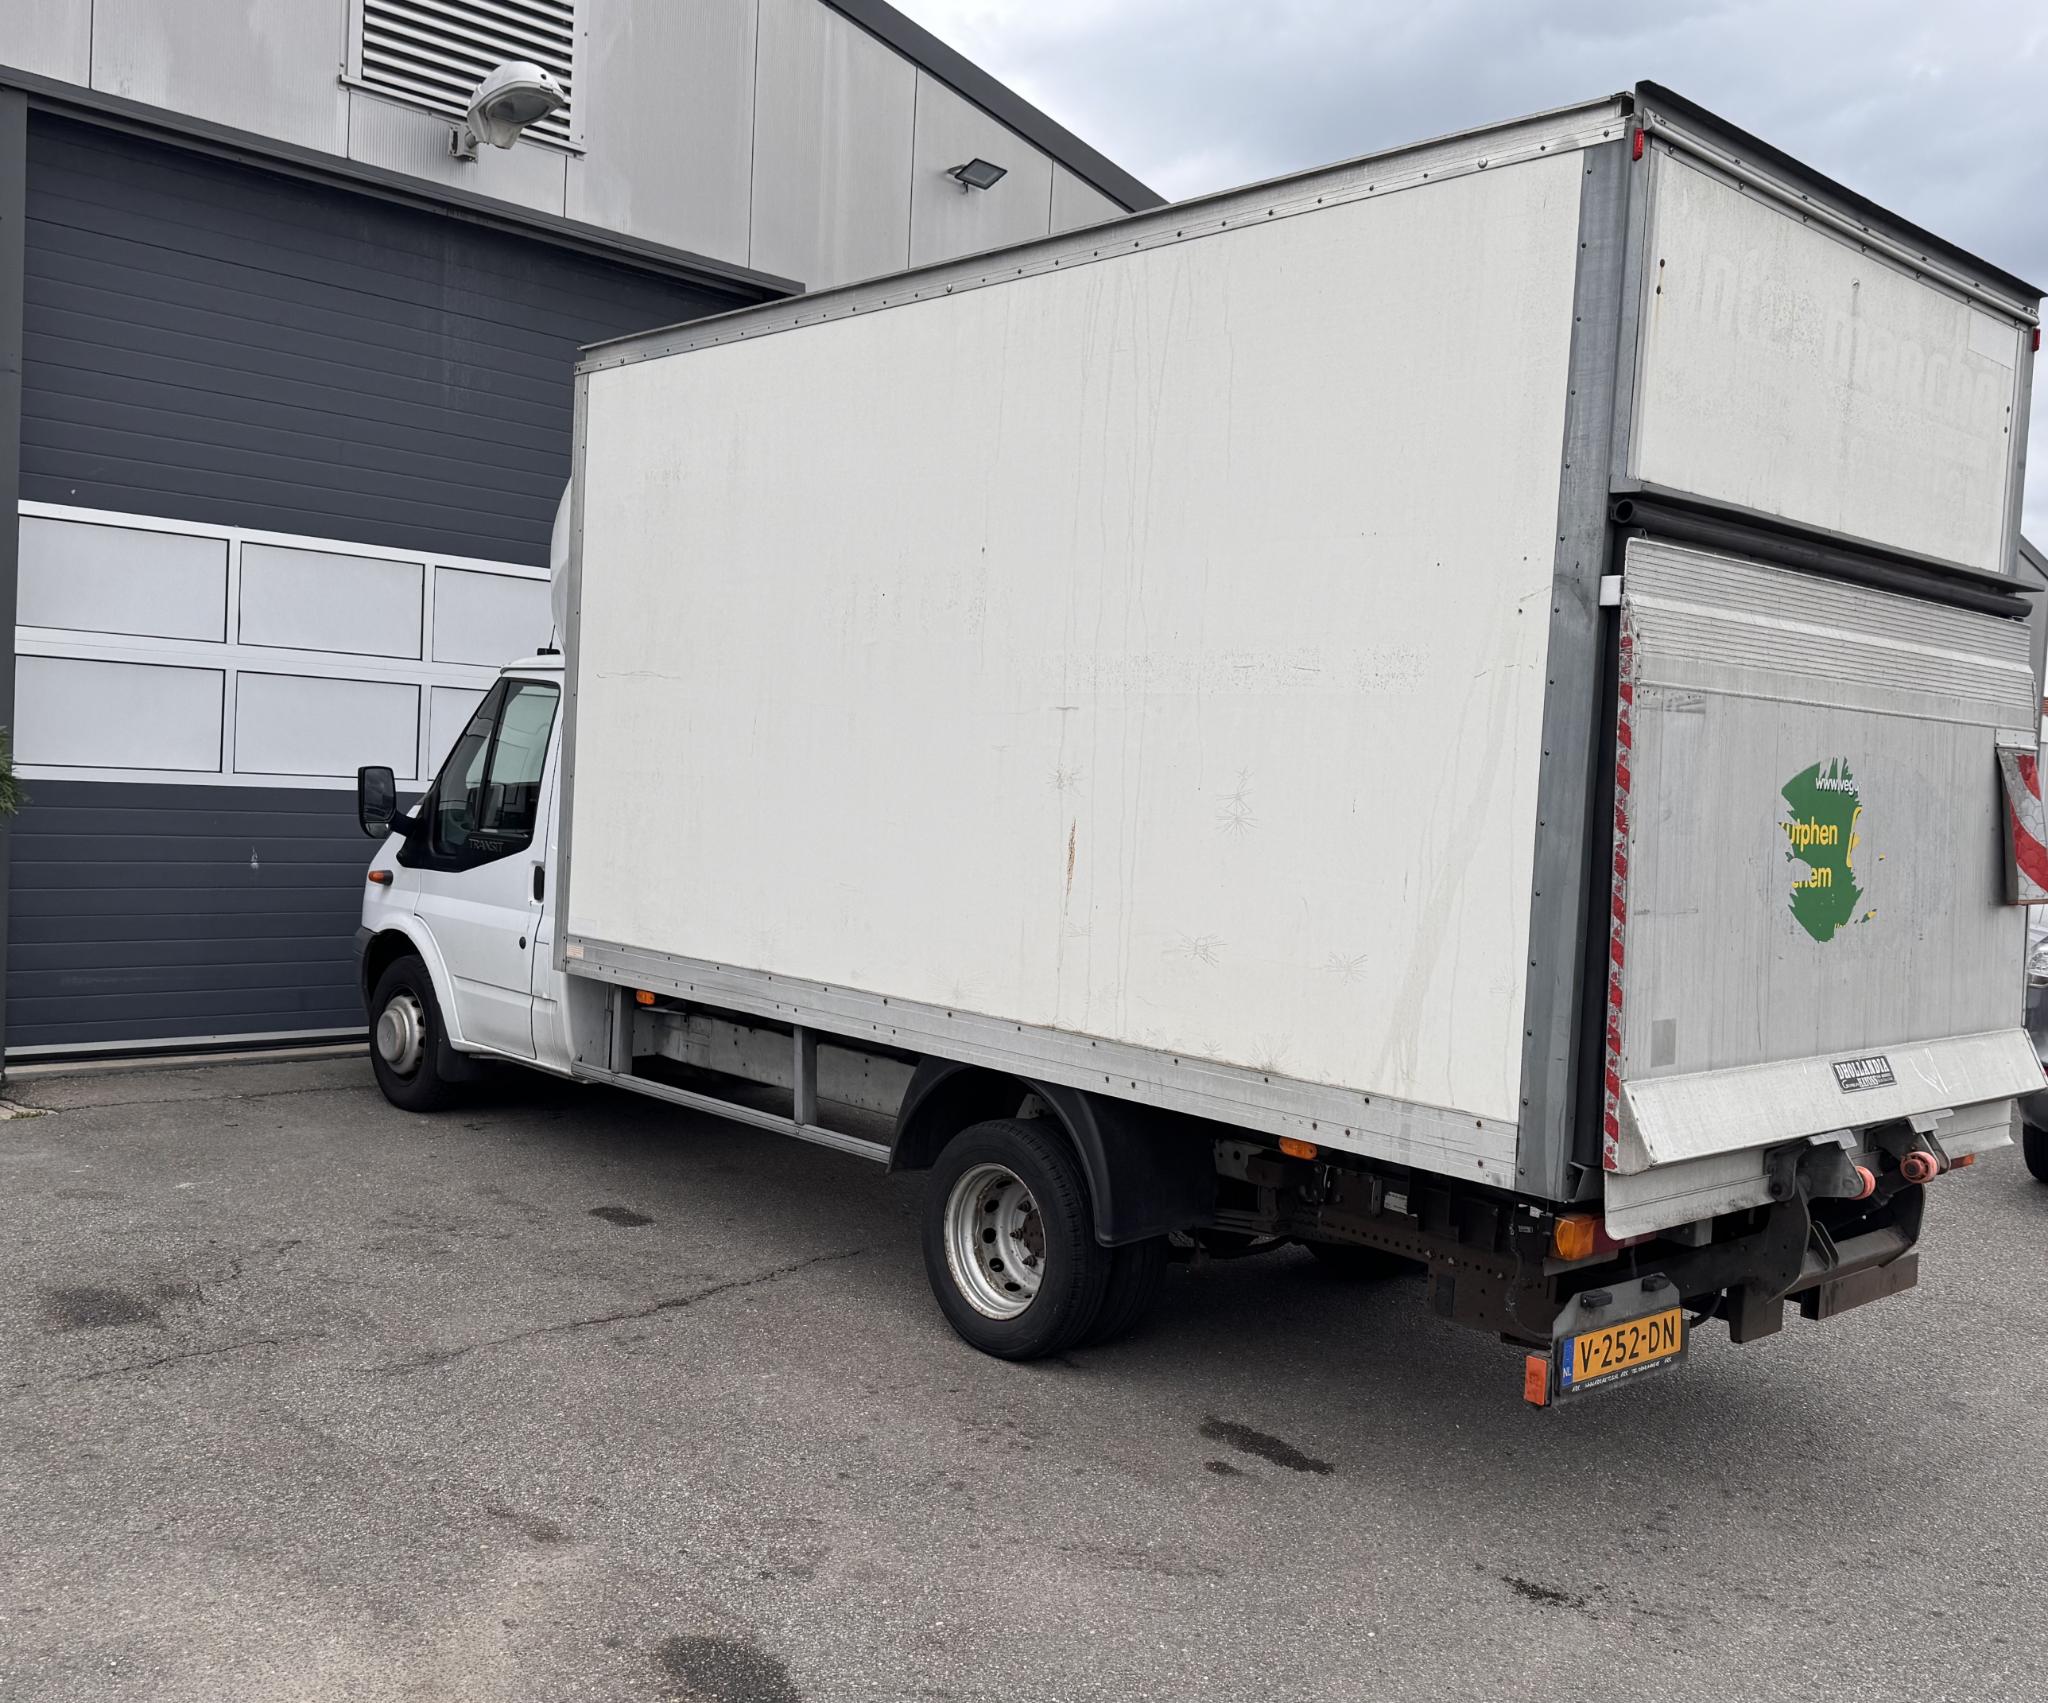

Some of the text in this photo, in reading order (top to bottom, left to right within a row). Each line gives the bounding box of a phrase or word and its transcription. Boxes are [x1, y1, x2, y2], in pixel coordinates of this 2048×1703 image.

[1780, 815, 1838, 852] utphen
[468, 838, 505, 853] TRANSIT
[1834, 1058, 1890, 1080] DHOLLANDIA
[1580, 1316, 1675, 1373] V-252-DN
[1562, 1367, 1572, 1378] NL
